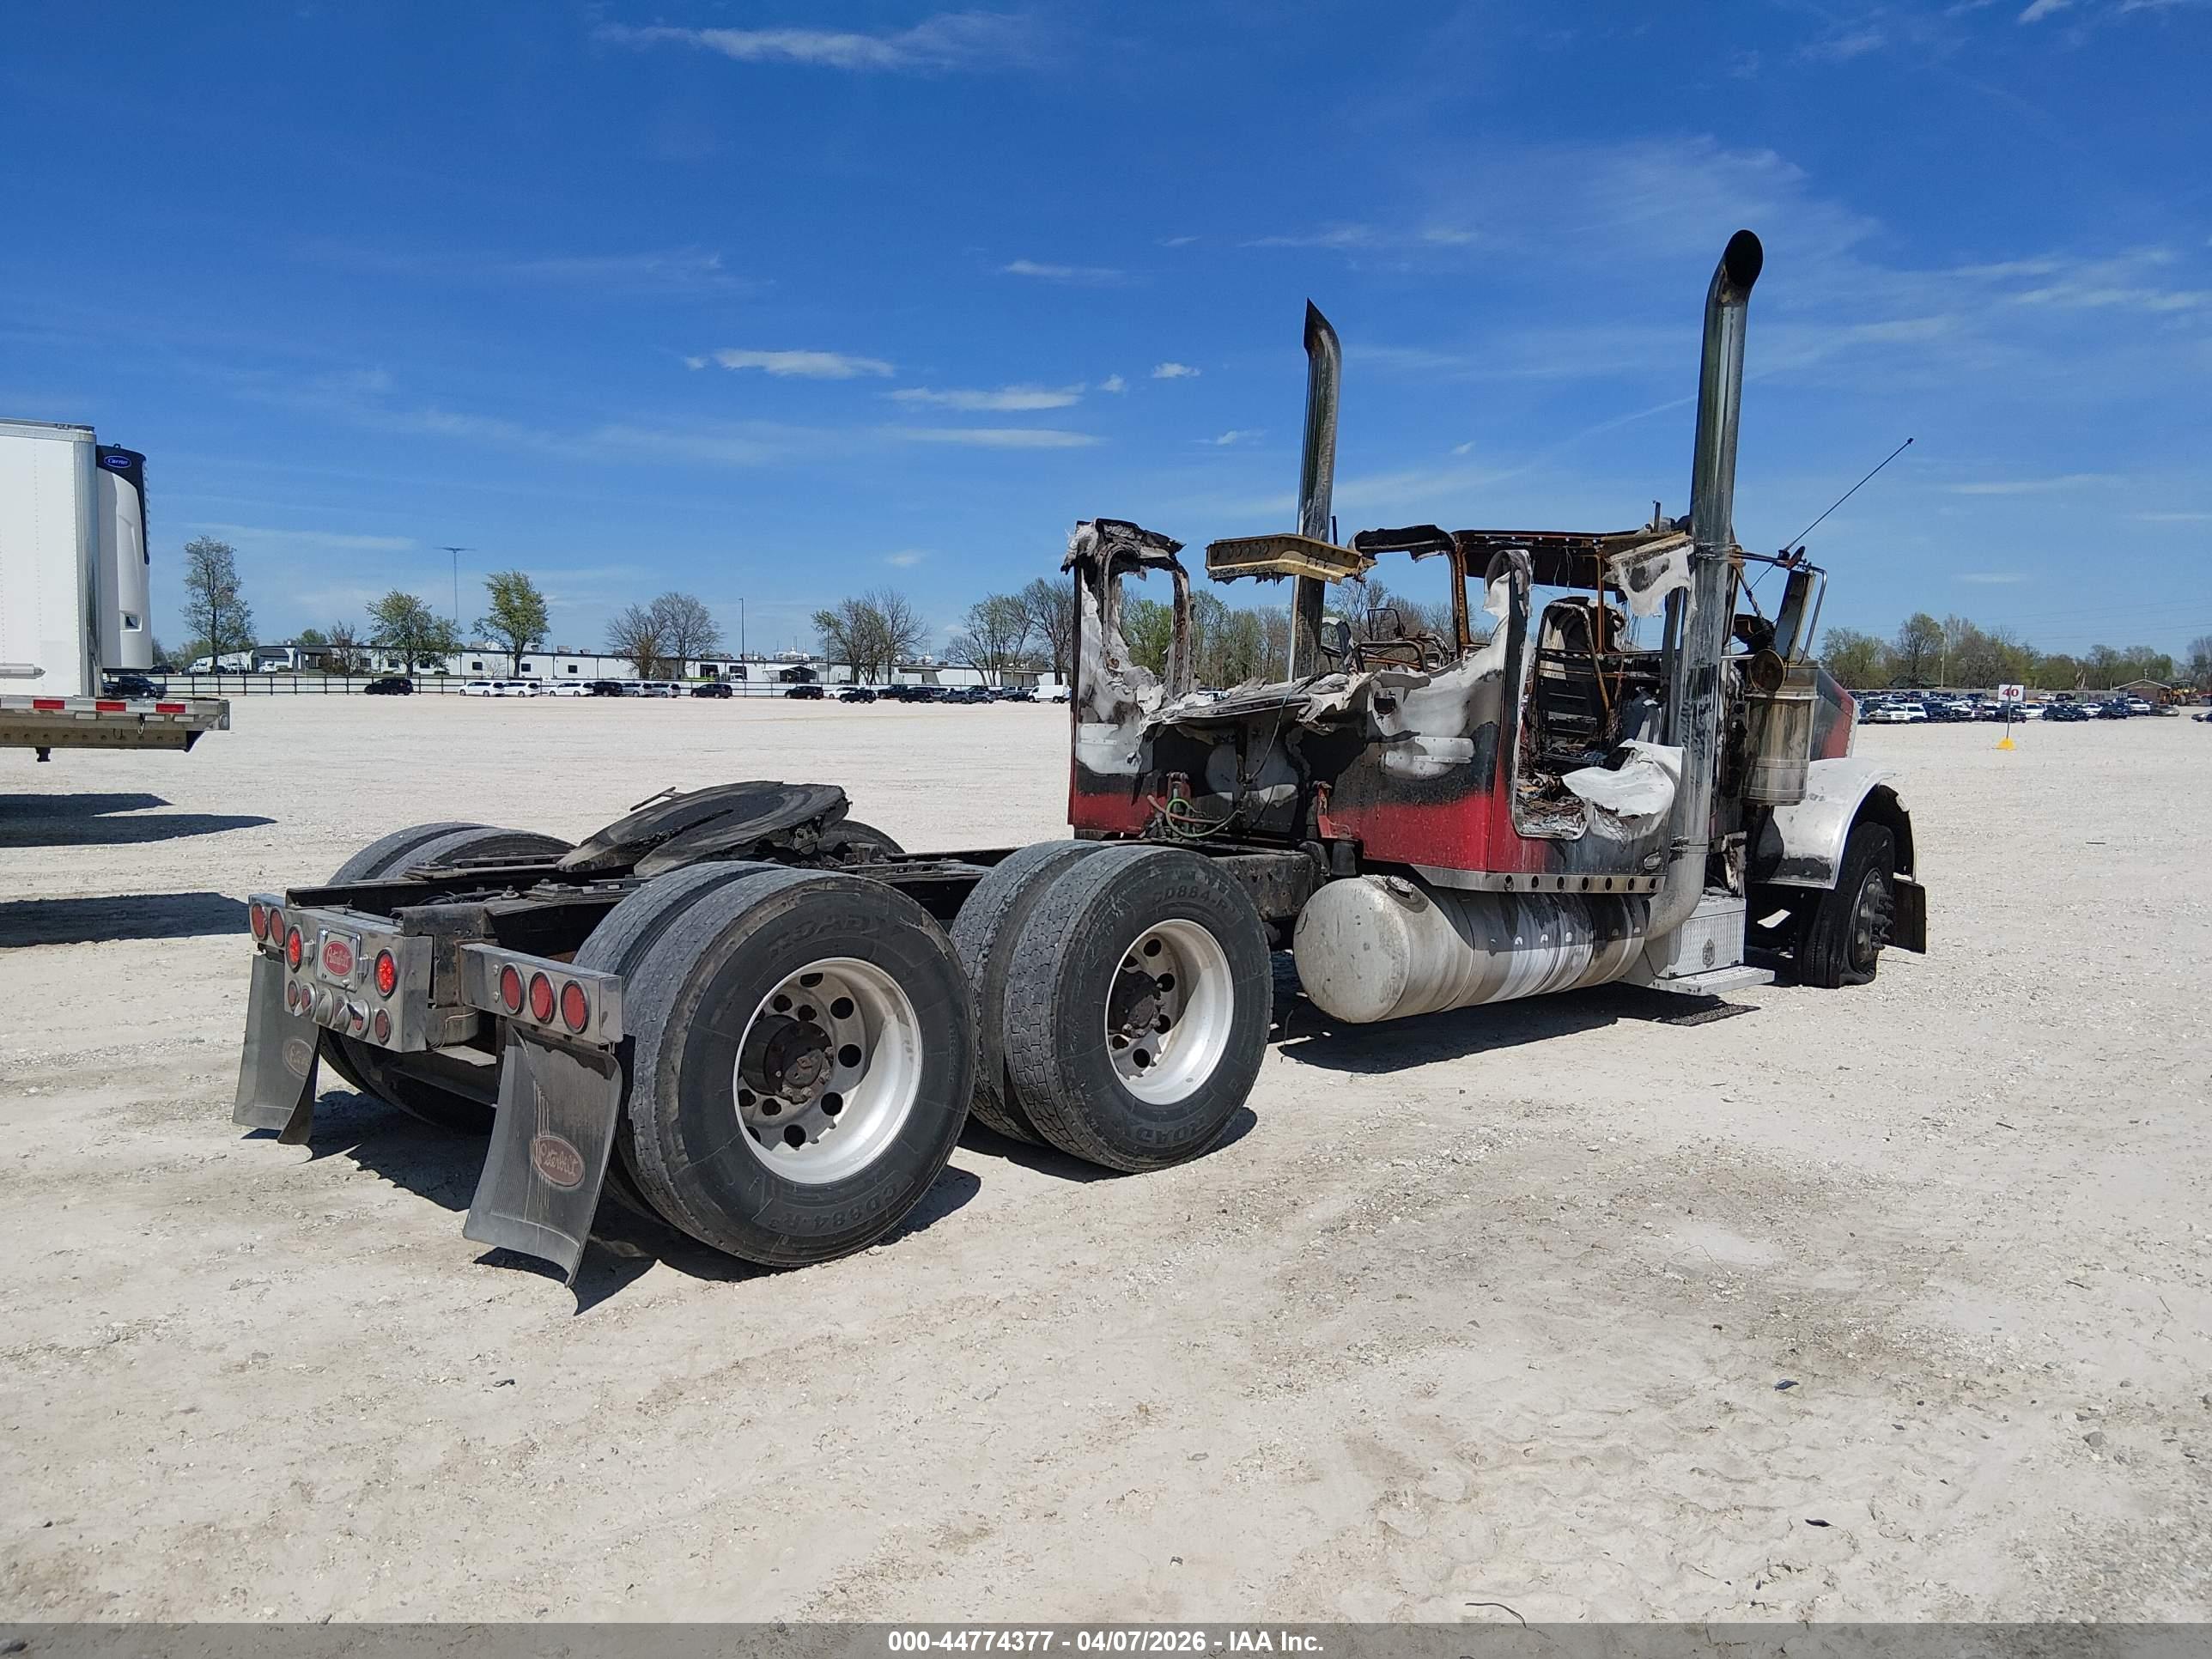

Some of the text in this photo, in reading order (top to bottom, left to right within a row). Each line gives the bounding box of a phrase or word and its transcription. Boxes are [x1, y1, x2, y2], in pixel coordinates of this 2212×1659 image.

[2002, 688, 2019, 696] 40
[326, 946, 351, 969] Peterbilt
[538, 1144, 579, 1176] Peterbilt
